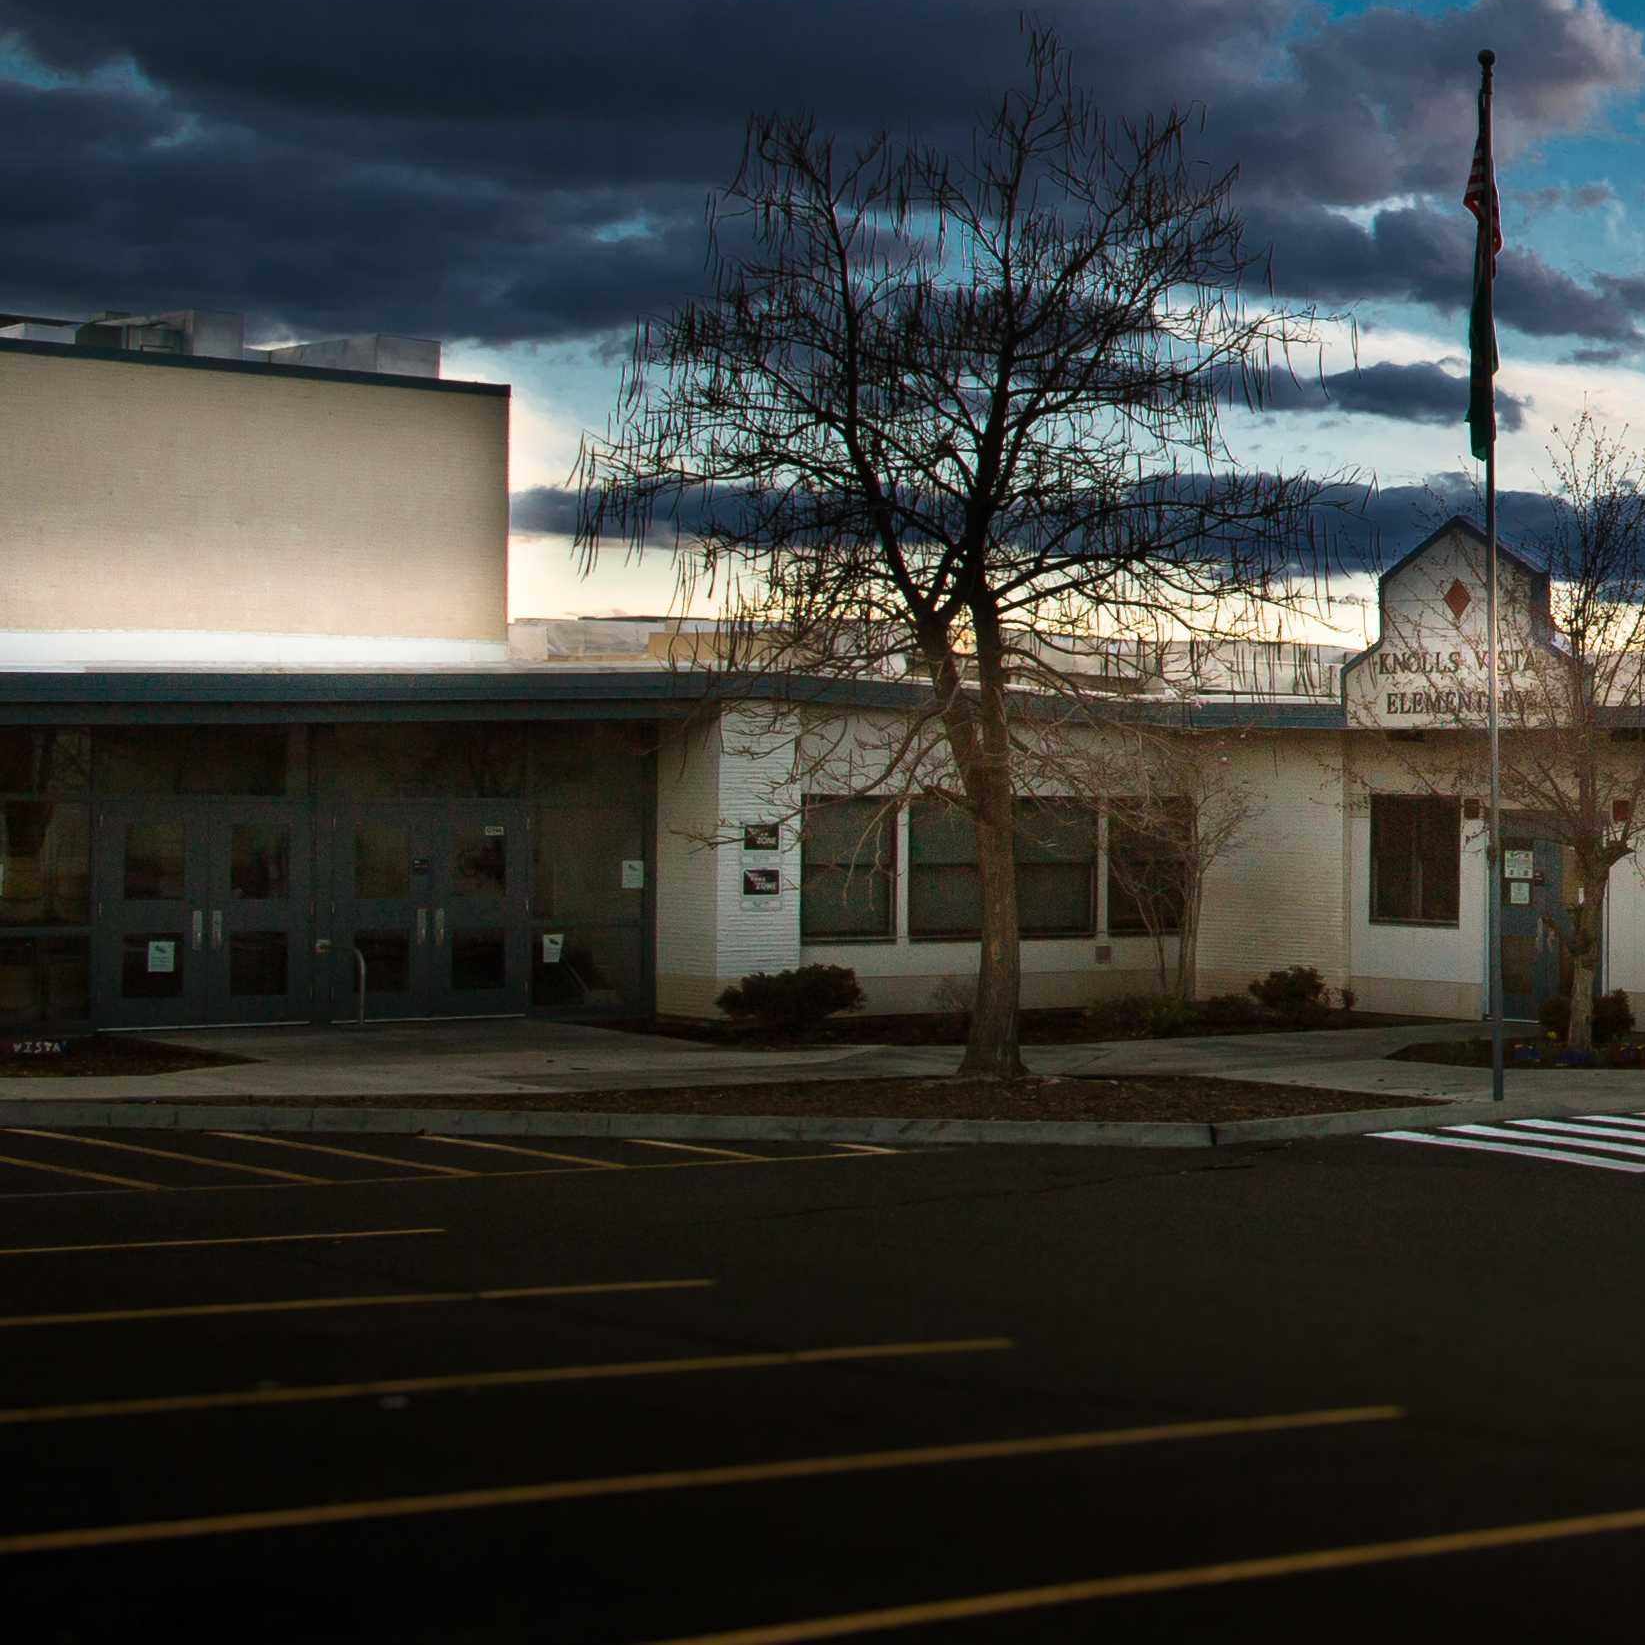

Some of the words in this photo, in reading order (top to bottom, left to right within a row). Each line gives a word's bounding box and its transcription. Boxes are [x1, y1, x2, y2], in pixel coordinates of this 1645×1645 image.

[1379, 652, 1460, 674] KNOLLS
[1474, 650, 1536, 671] VSTA
[1386, 690, 1533, 714] ELEMENTRY
